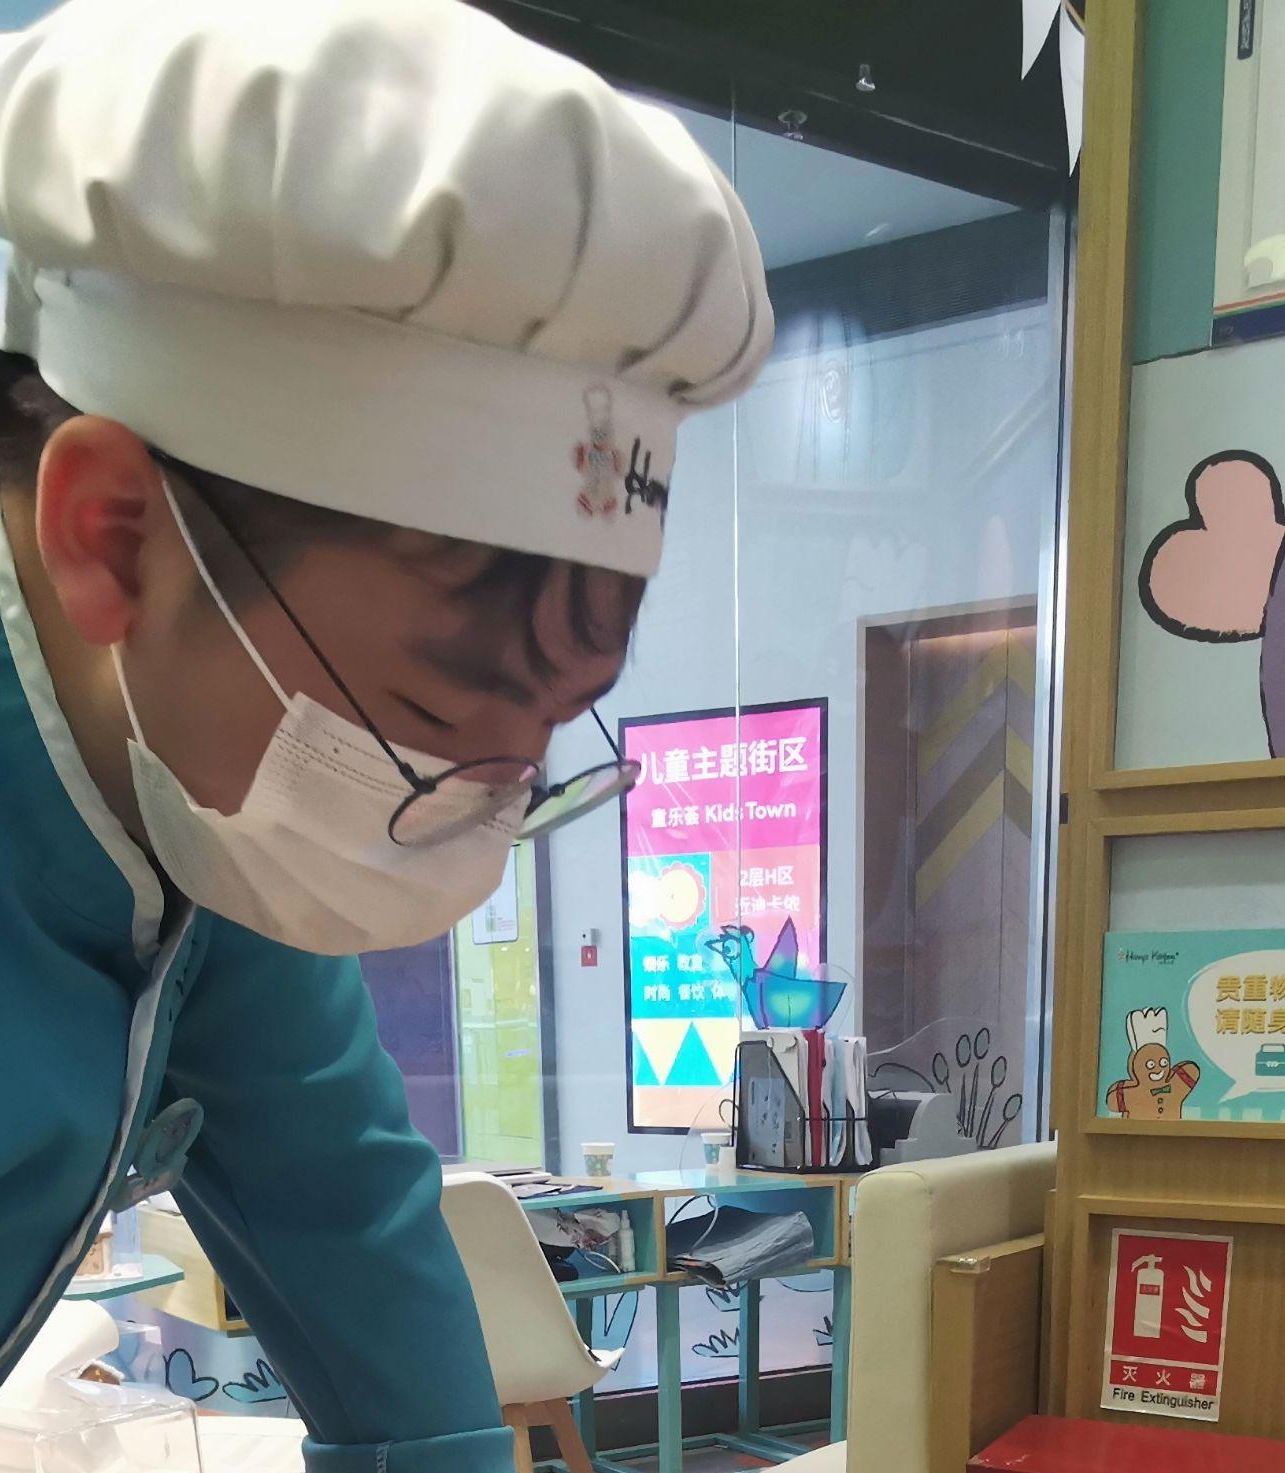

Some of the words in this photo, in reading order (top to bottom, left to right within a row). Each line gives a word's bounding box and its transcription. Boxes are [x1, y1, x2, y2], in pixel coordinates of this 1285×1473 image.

[635, 736, 809, 786] 儿童主题街区
[704, 802, 744, 824] Kids
[744, 800, 797, 820] Town
[1122, 1365, 1206, 1390] 灭火器
[1112, 1387, 1135, 1402] Fire
[1140, 1390, 1215, 1410] Extinguisher
